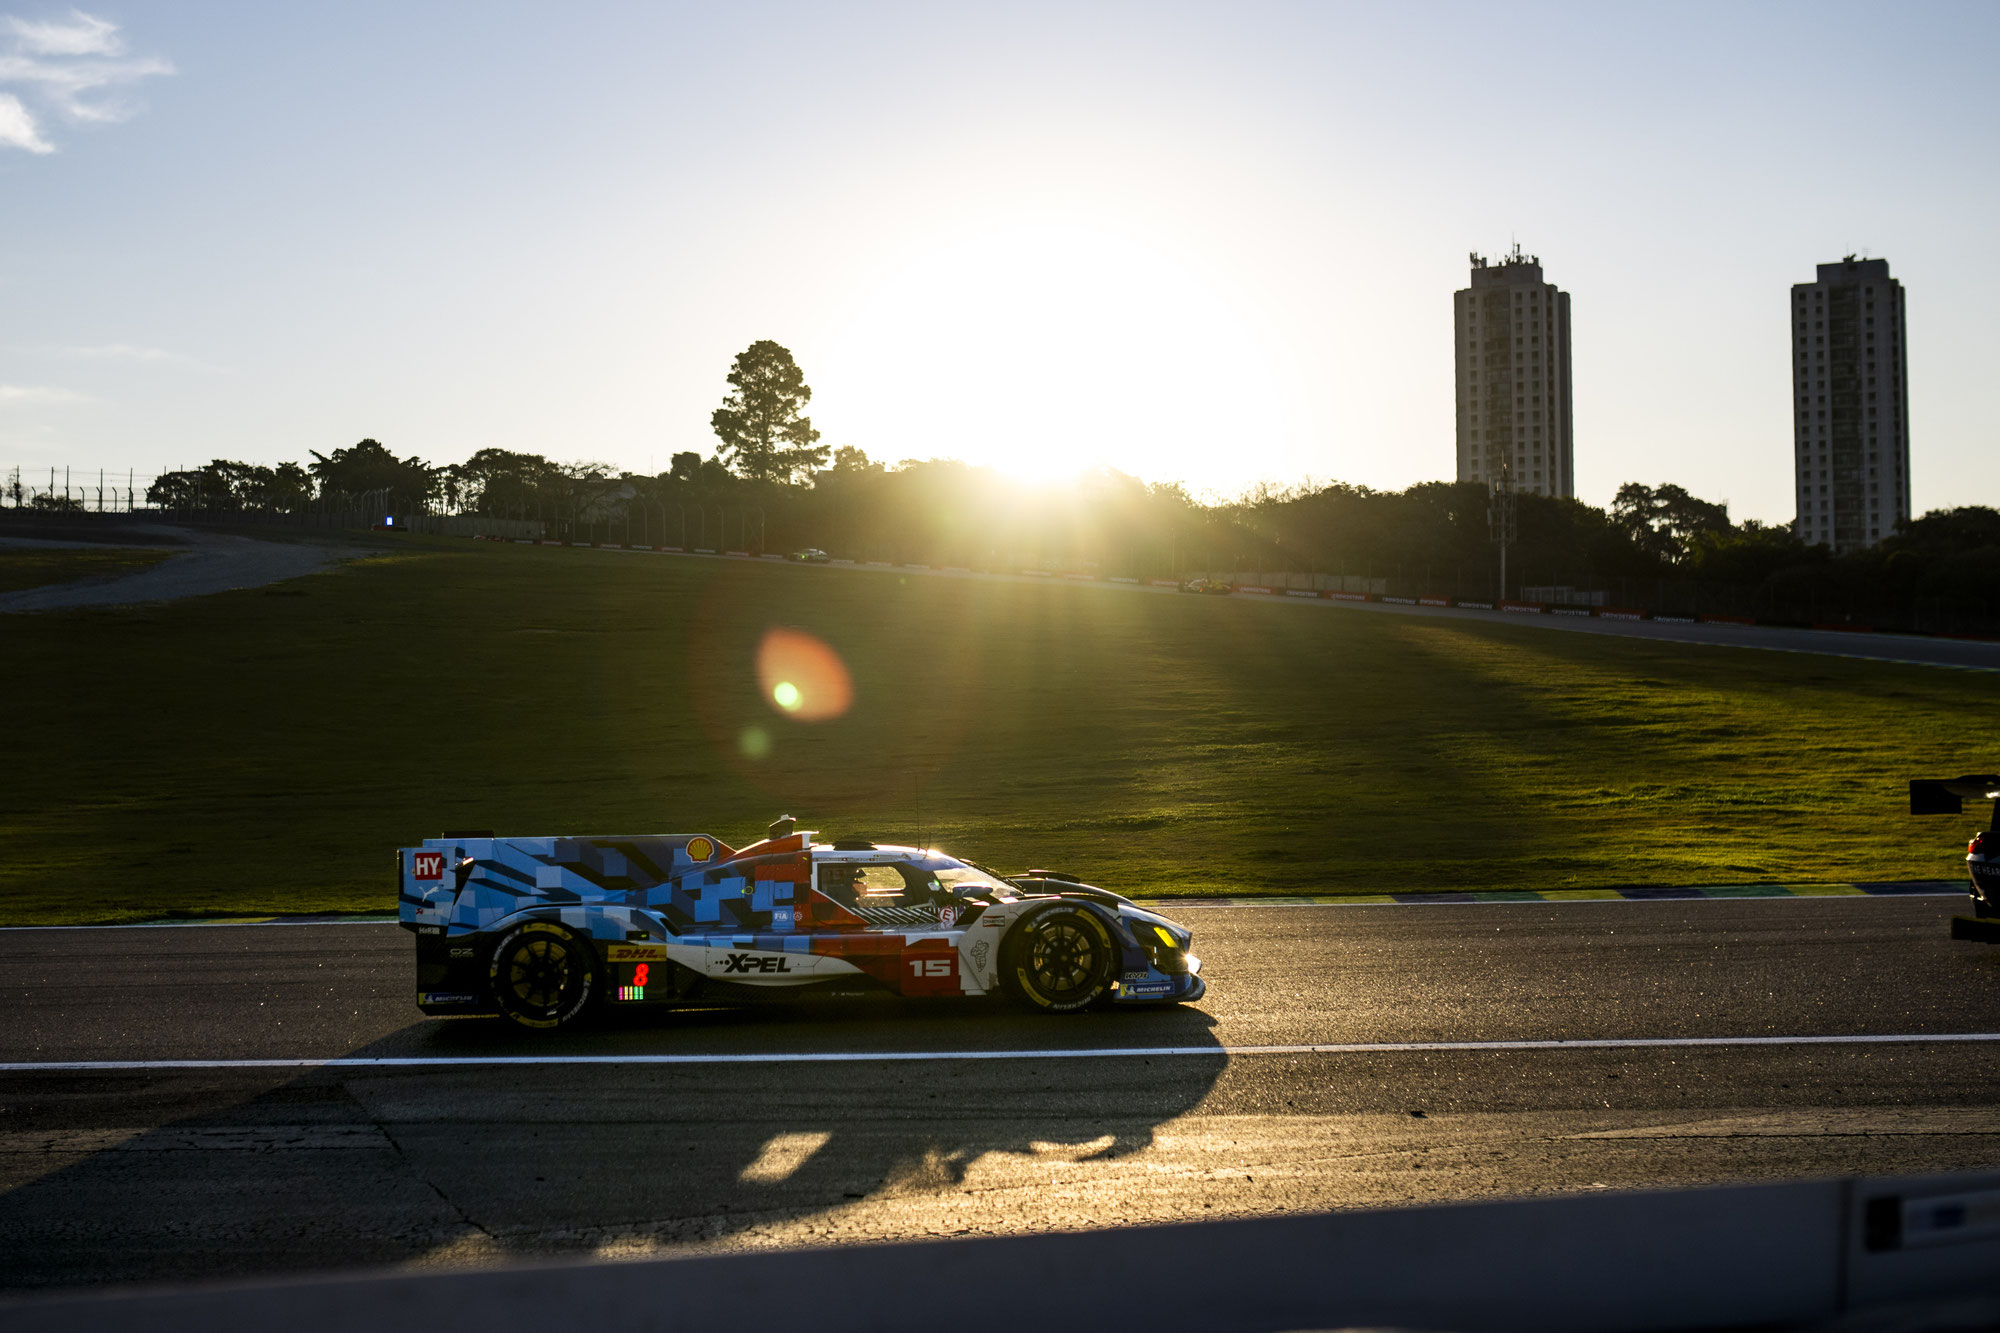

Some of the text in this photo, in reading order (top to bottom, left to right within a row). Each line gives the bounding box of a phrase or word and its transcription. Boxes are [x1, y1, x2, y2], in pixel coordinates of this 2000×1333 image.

[416, 857, 440, 876] HY
[774, 911, 789, 921] FIA
[943, 910, 952, 920] E
[616, 949, 657, 958] DHL
[724, 954, 791, 973] XPEL
[909, 960, 951, 977] 15
[633, 963, 649, 987] 8
